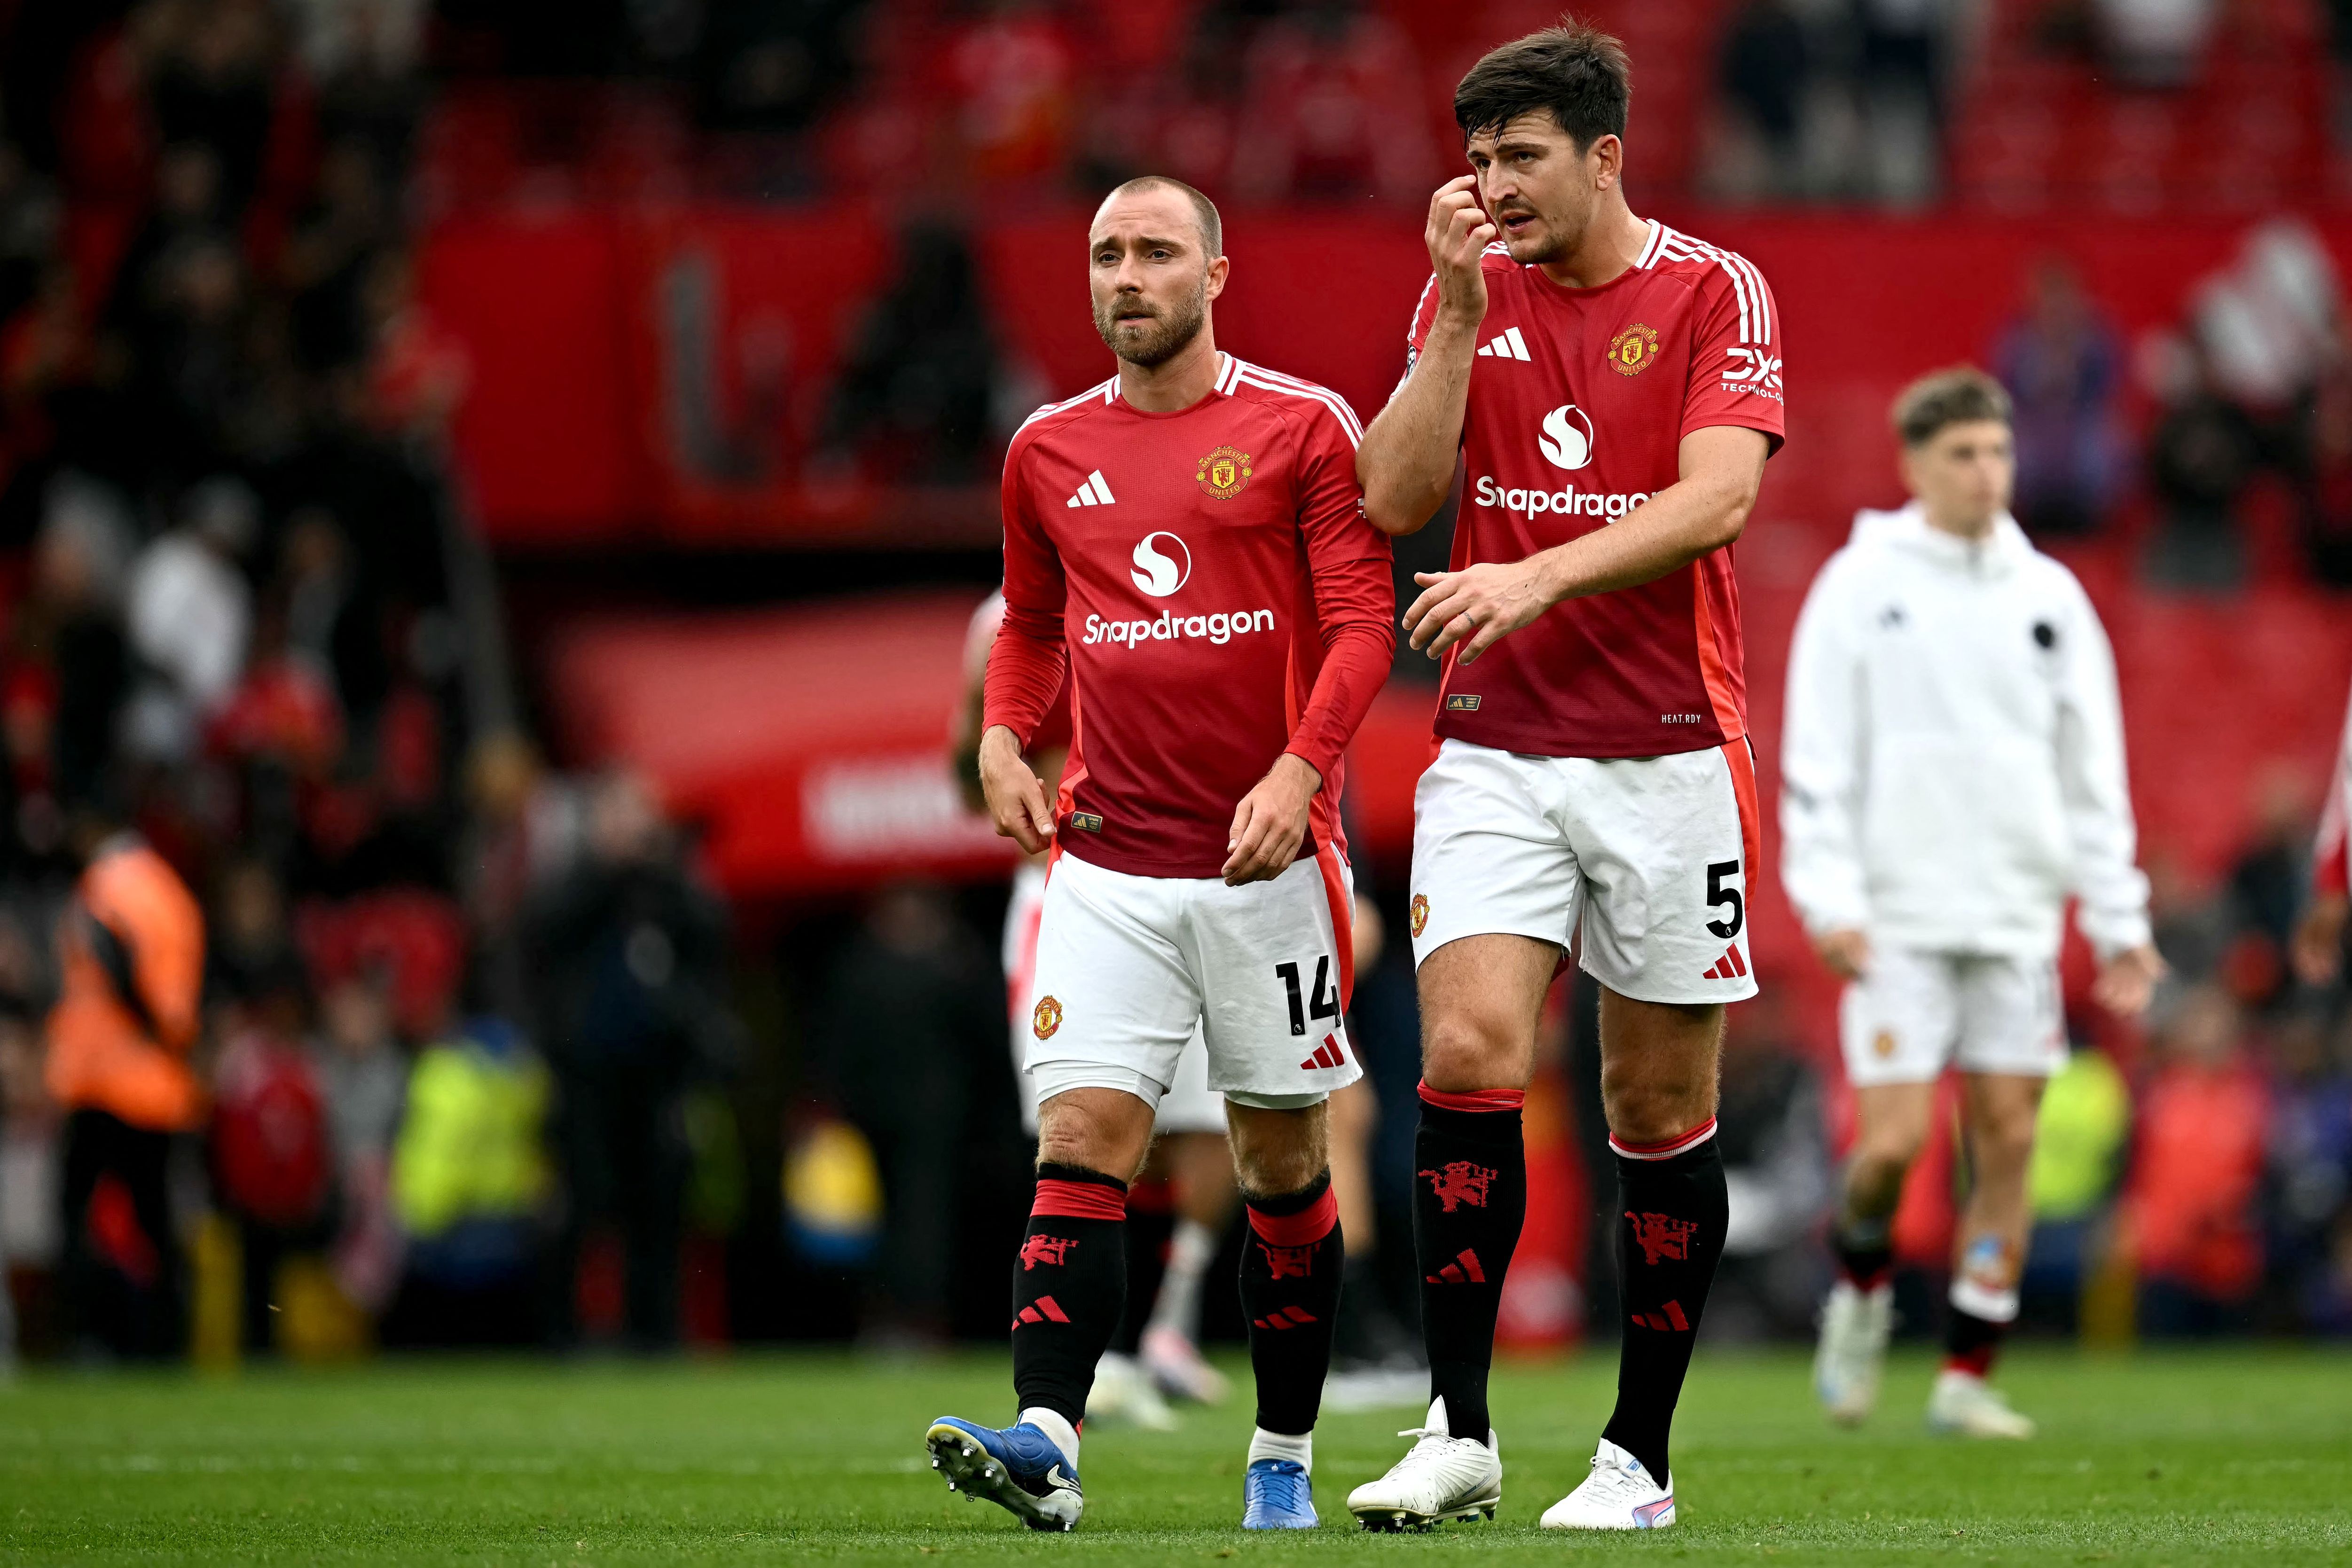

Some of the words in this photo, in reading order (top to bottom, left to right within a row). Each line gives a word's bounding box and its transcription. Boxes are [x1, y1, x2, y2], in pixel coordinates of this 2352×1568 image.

[1614, 326, 1653, 346] MANCHESTER
[1618, 361, 1646, 372] UNITED
[1201, 450, 1246, 468] MANCHESTER
[1209, 485, 1240, 496] UNITED
[1475, 476, 1664, 524] Snapdrago
[1082, 609, 1274, 649] Snapdragon
[1662, 714, 1701, 723] HEAT.RDY
[1706, 859, 1743, 939] 5
[1275, 955, 1341, 1036] 14
